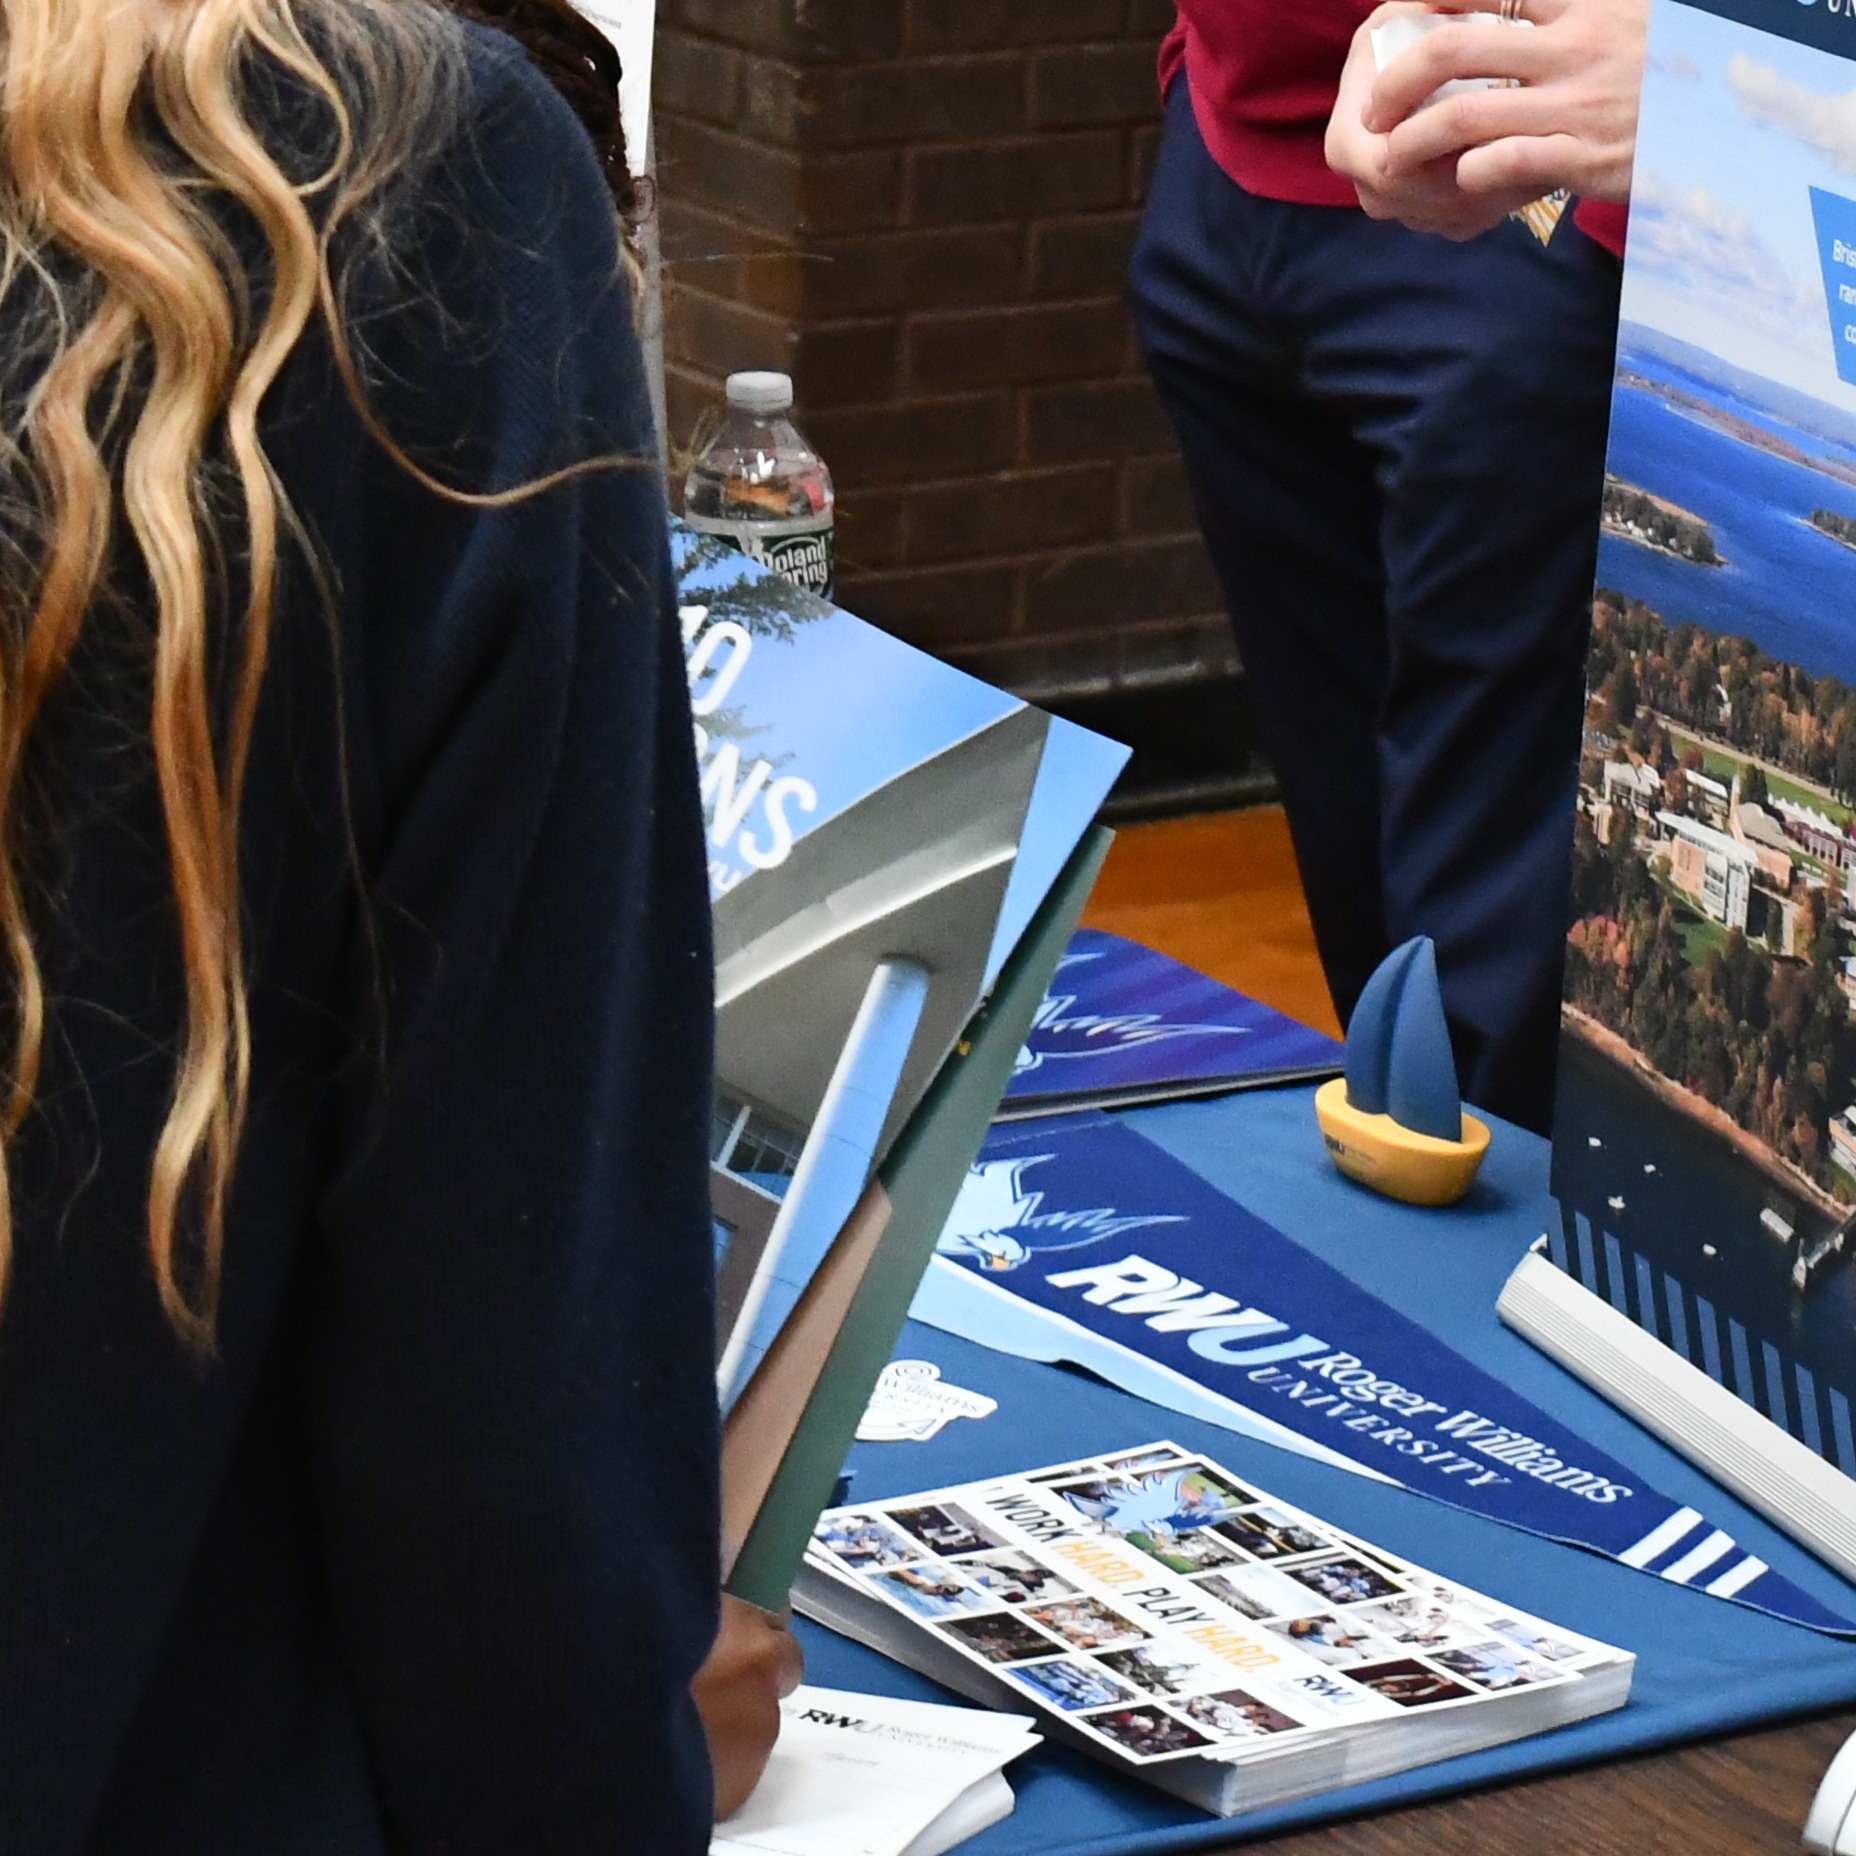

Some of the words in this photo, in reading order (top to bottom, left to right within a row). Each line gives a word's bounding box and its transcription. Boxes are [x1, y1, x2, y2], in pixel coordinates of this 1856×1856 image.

[1045, 1254, 1330, 1366] RWU
[1247, 1367, 1514, 1488] UNIVERSITY
[1298, 1351, 1448, 1417] Roger
[1435, 1411, 1633, 1505] Williams
[986, 1493, 1082, 1543] WORK
[1052, 1541, 1144, 1589] HARD.
[1123, 1586, 1214, 1625] PLAY
[1184, 1624, 1280, 1672] HARD.
[800, 1708, 885, 1734] RWU
[1293, 1674, 1367, 1705] RWU
